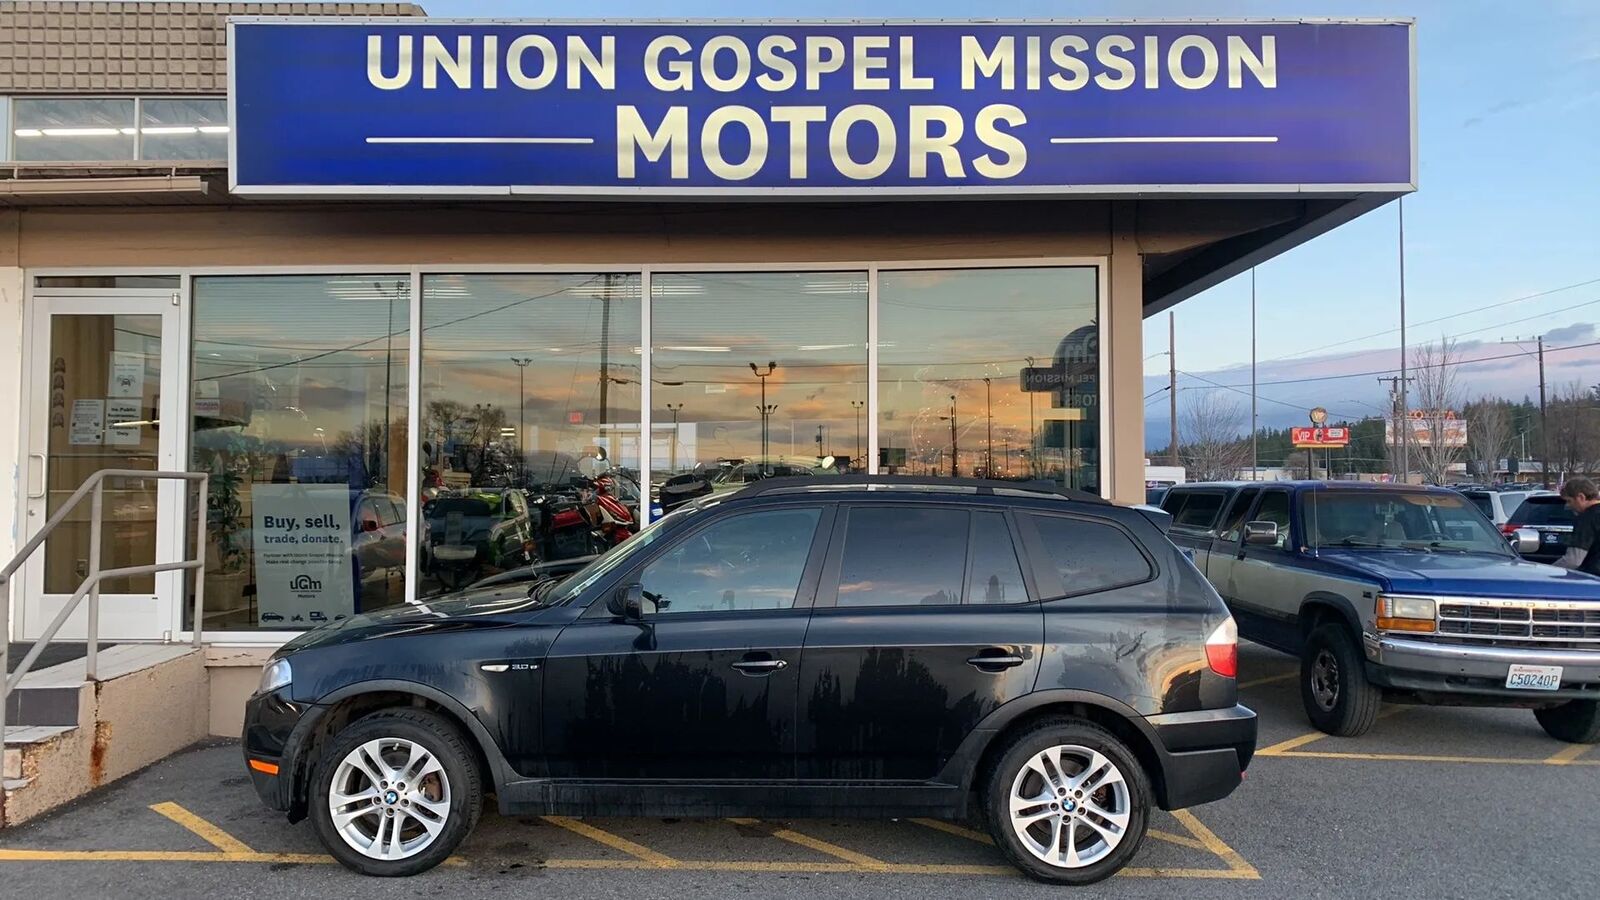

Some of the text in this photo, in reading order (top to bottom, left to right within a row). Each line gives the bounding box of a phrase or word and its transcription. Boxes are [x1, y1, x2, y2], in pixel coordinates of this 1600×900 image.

[367, 34, 1277, 92] UNION GOSPEL MISSION
[616, 103, 1028, 181] MOTORS
[1297, 431, 1310, 440] VIP
[264, 514, 340, 531] Buy, sell,
[264, 534, 343, 544] trade, donate.
